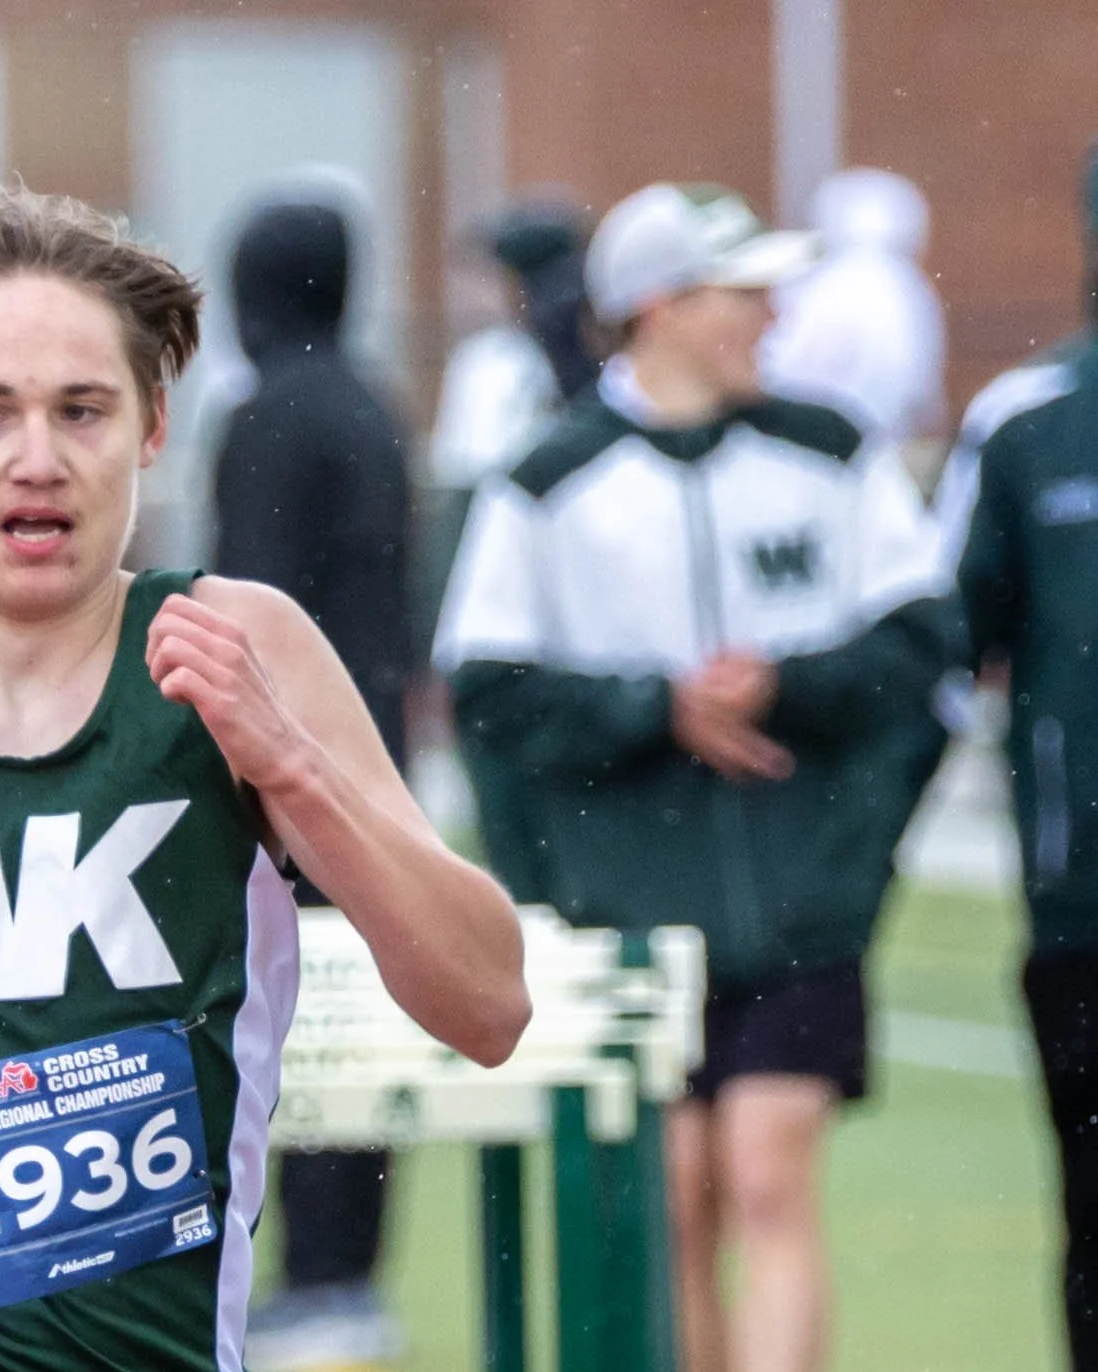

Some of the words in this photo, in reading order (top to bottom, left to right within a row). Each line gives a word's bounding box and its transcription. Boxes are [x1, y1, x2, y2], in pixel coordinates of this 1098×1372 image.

[43, 1044, 119, 1075] CROSS
[47, 1054, 149, 1092] COUNTRY
[54, 1072, 165, 1116] CHAMPIONSHIP
[174, 1224, 212, 1247] 2936
